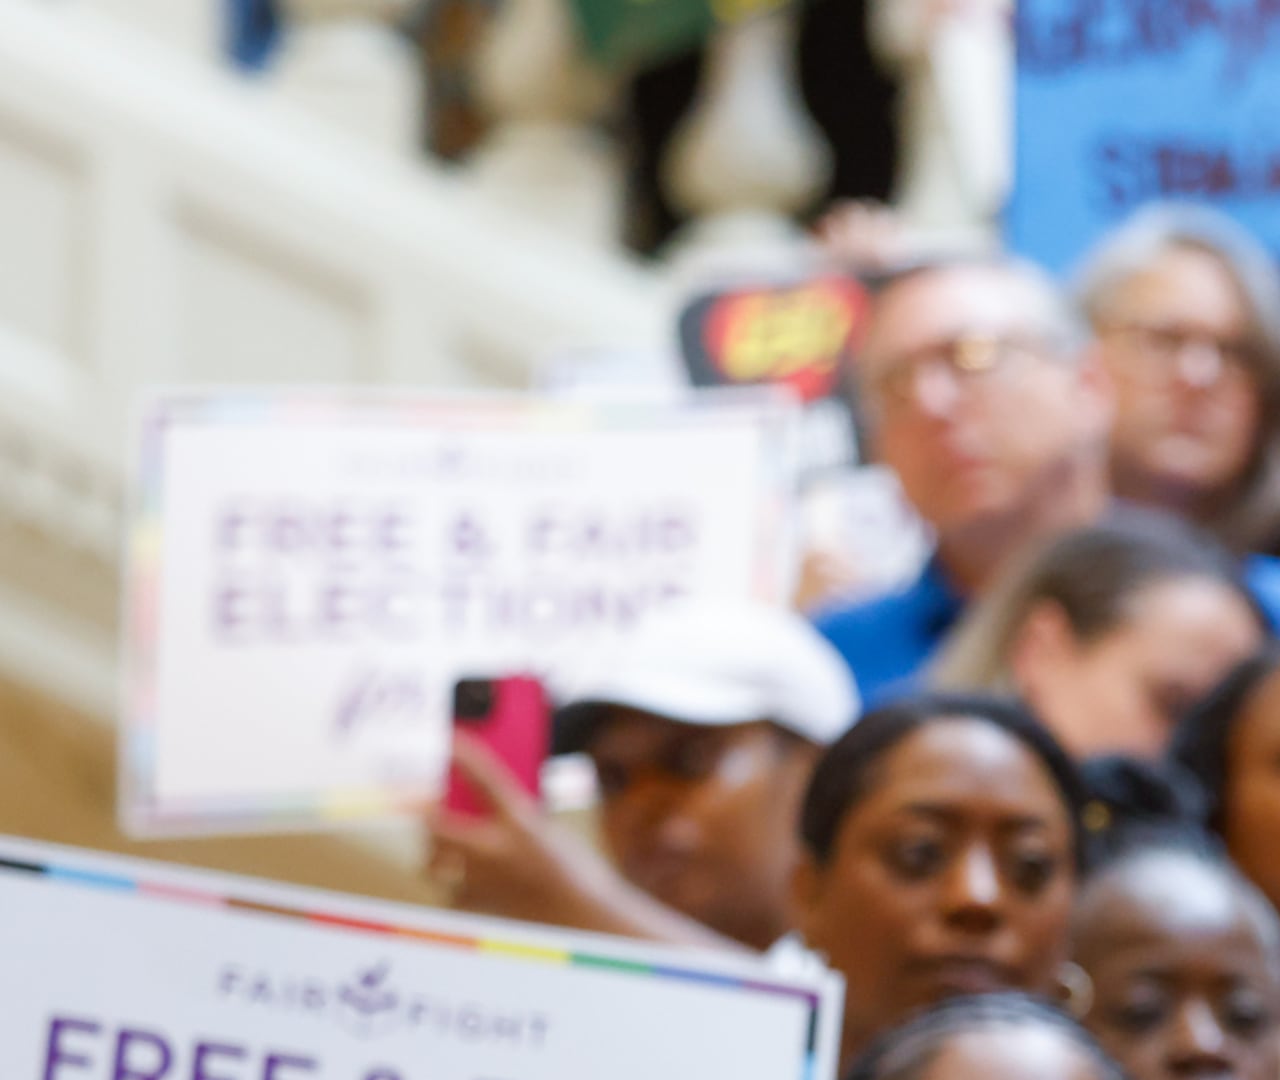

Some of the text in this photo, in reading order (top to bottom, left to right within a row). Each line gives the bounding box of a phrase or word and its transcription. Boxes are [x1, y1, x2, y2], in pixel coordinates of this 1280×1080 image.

[212, 497, 416, 554] FREE
[217, 963, 549, 1045] FAIR FIGHT
